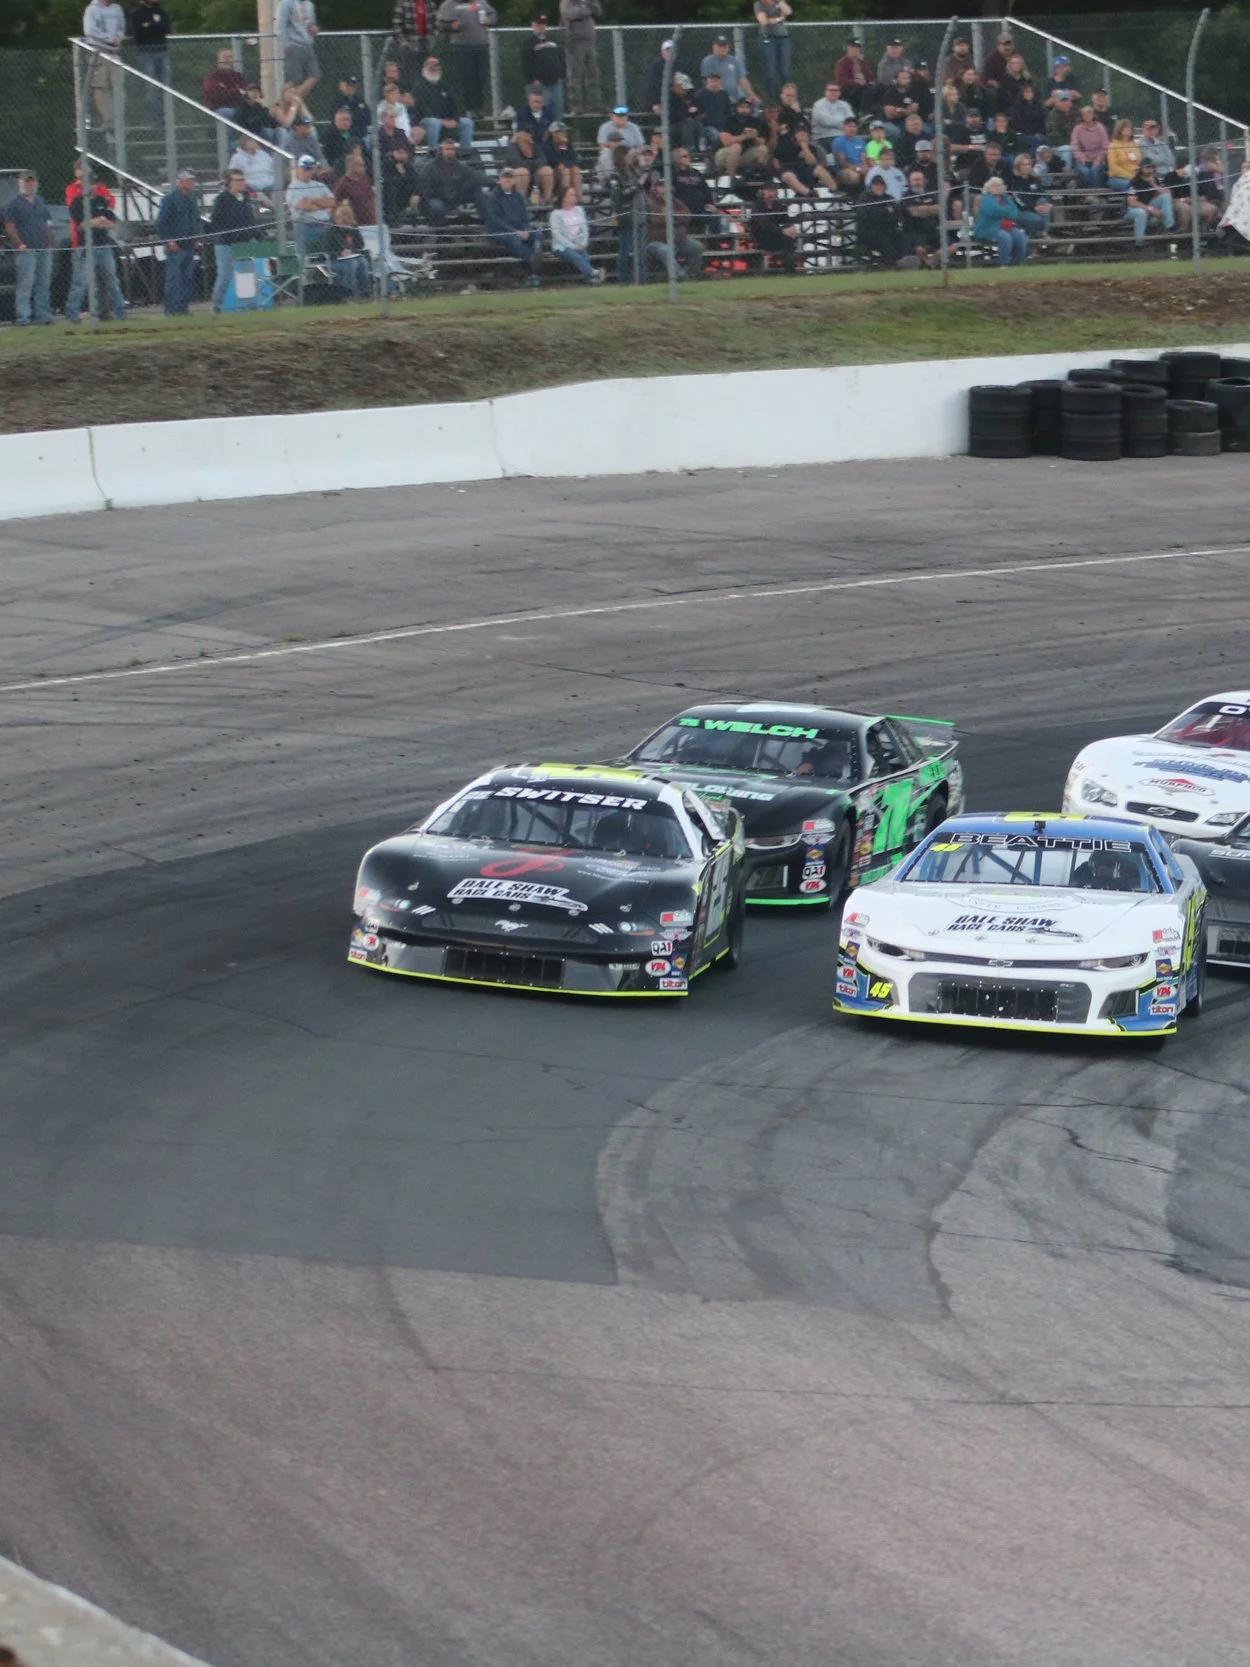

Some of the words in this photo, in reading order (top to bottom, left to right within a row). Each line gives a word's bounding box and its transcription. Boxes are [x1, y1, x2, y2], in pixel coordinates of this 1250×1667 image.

[704, 719, 819, 739] WELCH
[494, 786, 648, 810] SWITSER
[950, 832, 1132, 852] BEATTIE
[453, 888, 487, 899] RACE
[492, 890, 532, 900] CARS
[462, 880, 503, 891] DALE
[508, 882, 563, 897] SHAW
[956, 915, 1000, 924] DALE
[1004, 917, 1058, 927] SHAW
[653, 942, 672, 954] QA1
[869, 982, 894, 998] 45
[1151, 1005, 1174, 1014] tilton
